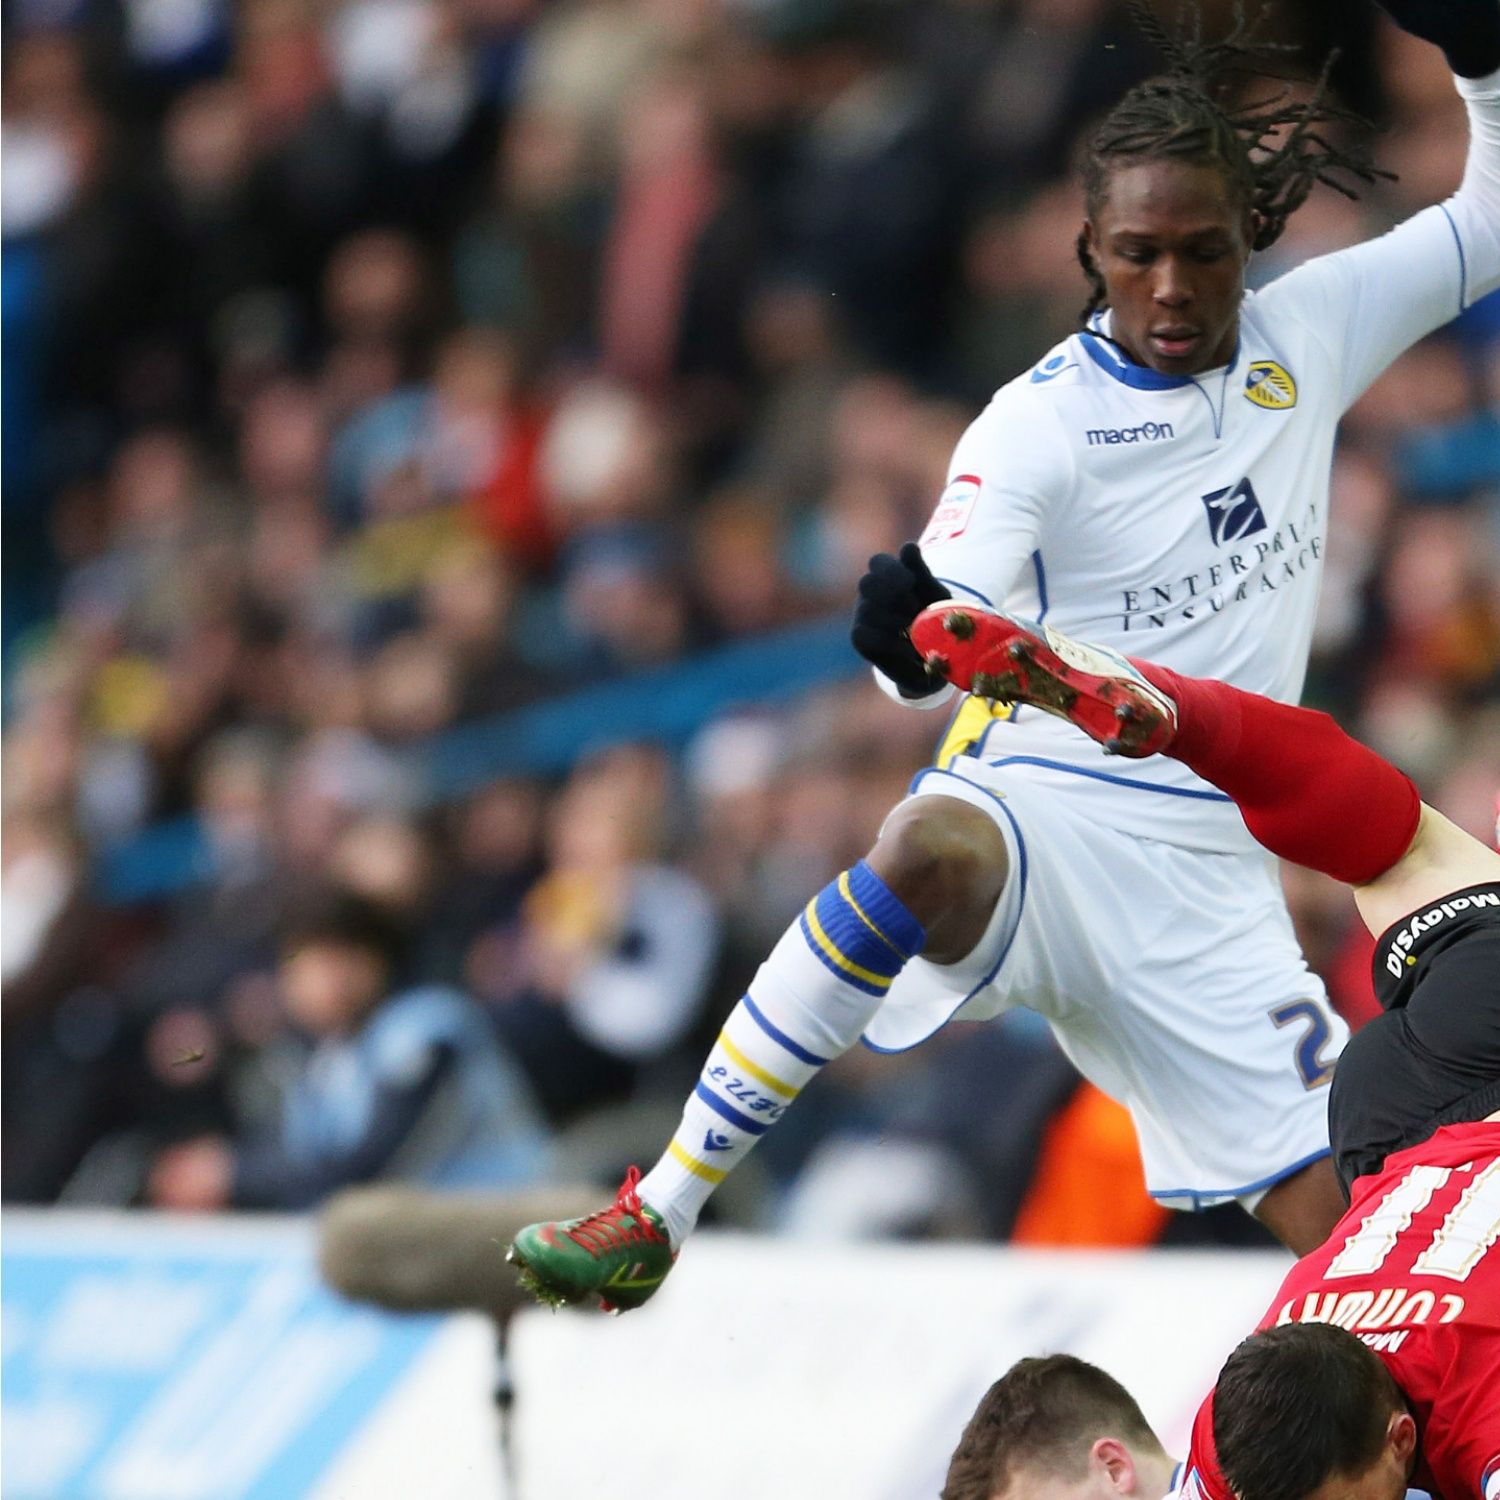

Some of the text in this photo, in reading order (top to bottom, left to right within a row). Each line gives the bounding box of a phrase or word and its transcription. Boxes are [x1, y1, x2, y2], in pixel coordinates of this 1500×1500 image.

[1086, 422, 1175, 445] macron
[1121, 536, 1320, 632] INSURANCE
[1122, 503, 1317, 612] ENTERPRI
[1386, 893, 1500, 979] Malaysia
